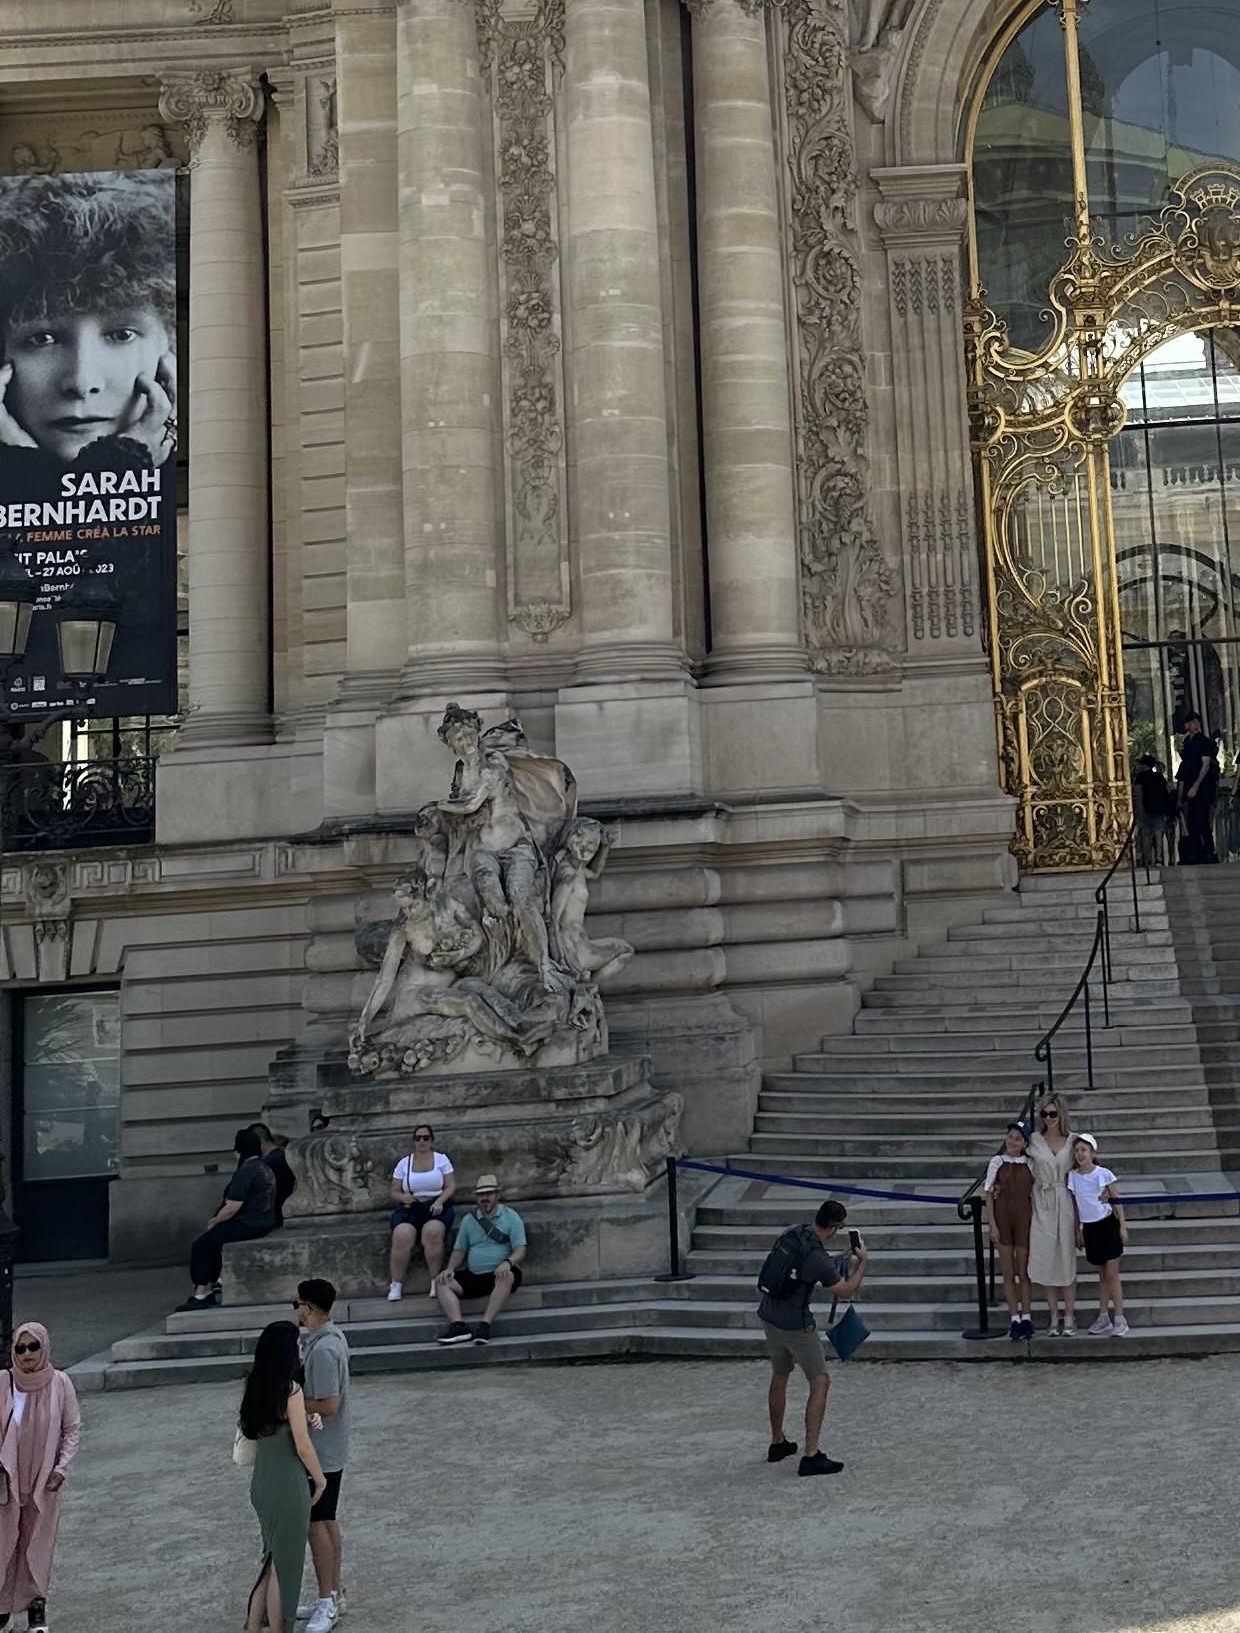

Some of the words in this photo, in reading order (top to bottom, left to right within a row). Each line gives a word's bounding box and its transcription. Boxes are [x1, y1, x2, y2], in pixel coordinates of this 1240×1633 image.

[61, 468, 161, 497] SARAH
[26, 529, 73, 543] FEMME
[76, 525, 110, 540] CRÉA
[113, 527, 129, 538] LA
[131, 524, 161, 536] STAR
[42, 567, 54, 577] 27
[56, 563, 84, 576] AOÛ
[89, 563, 114, 575] 023
